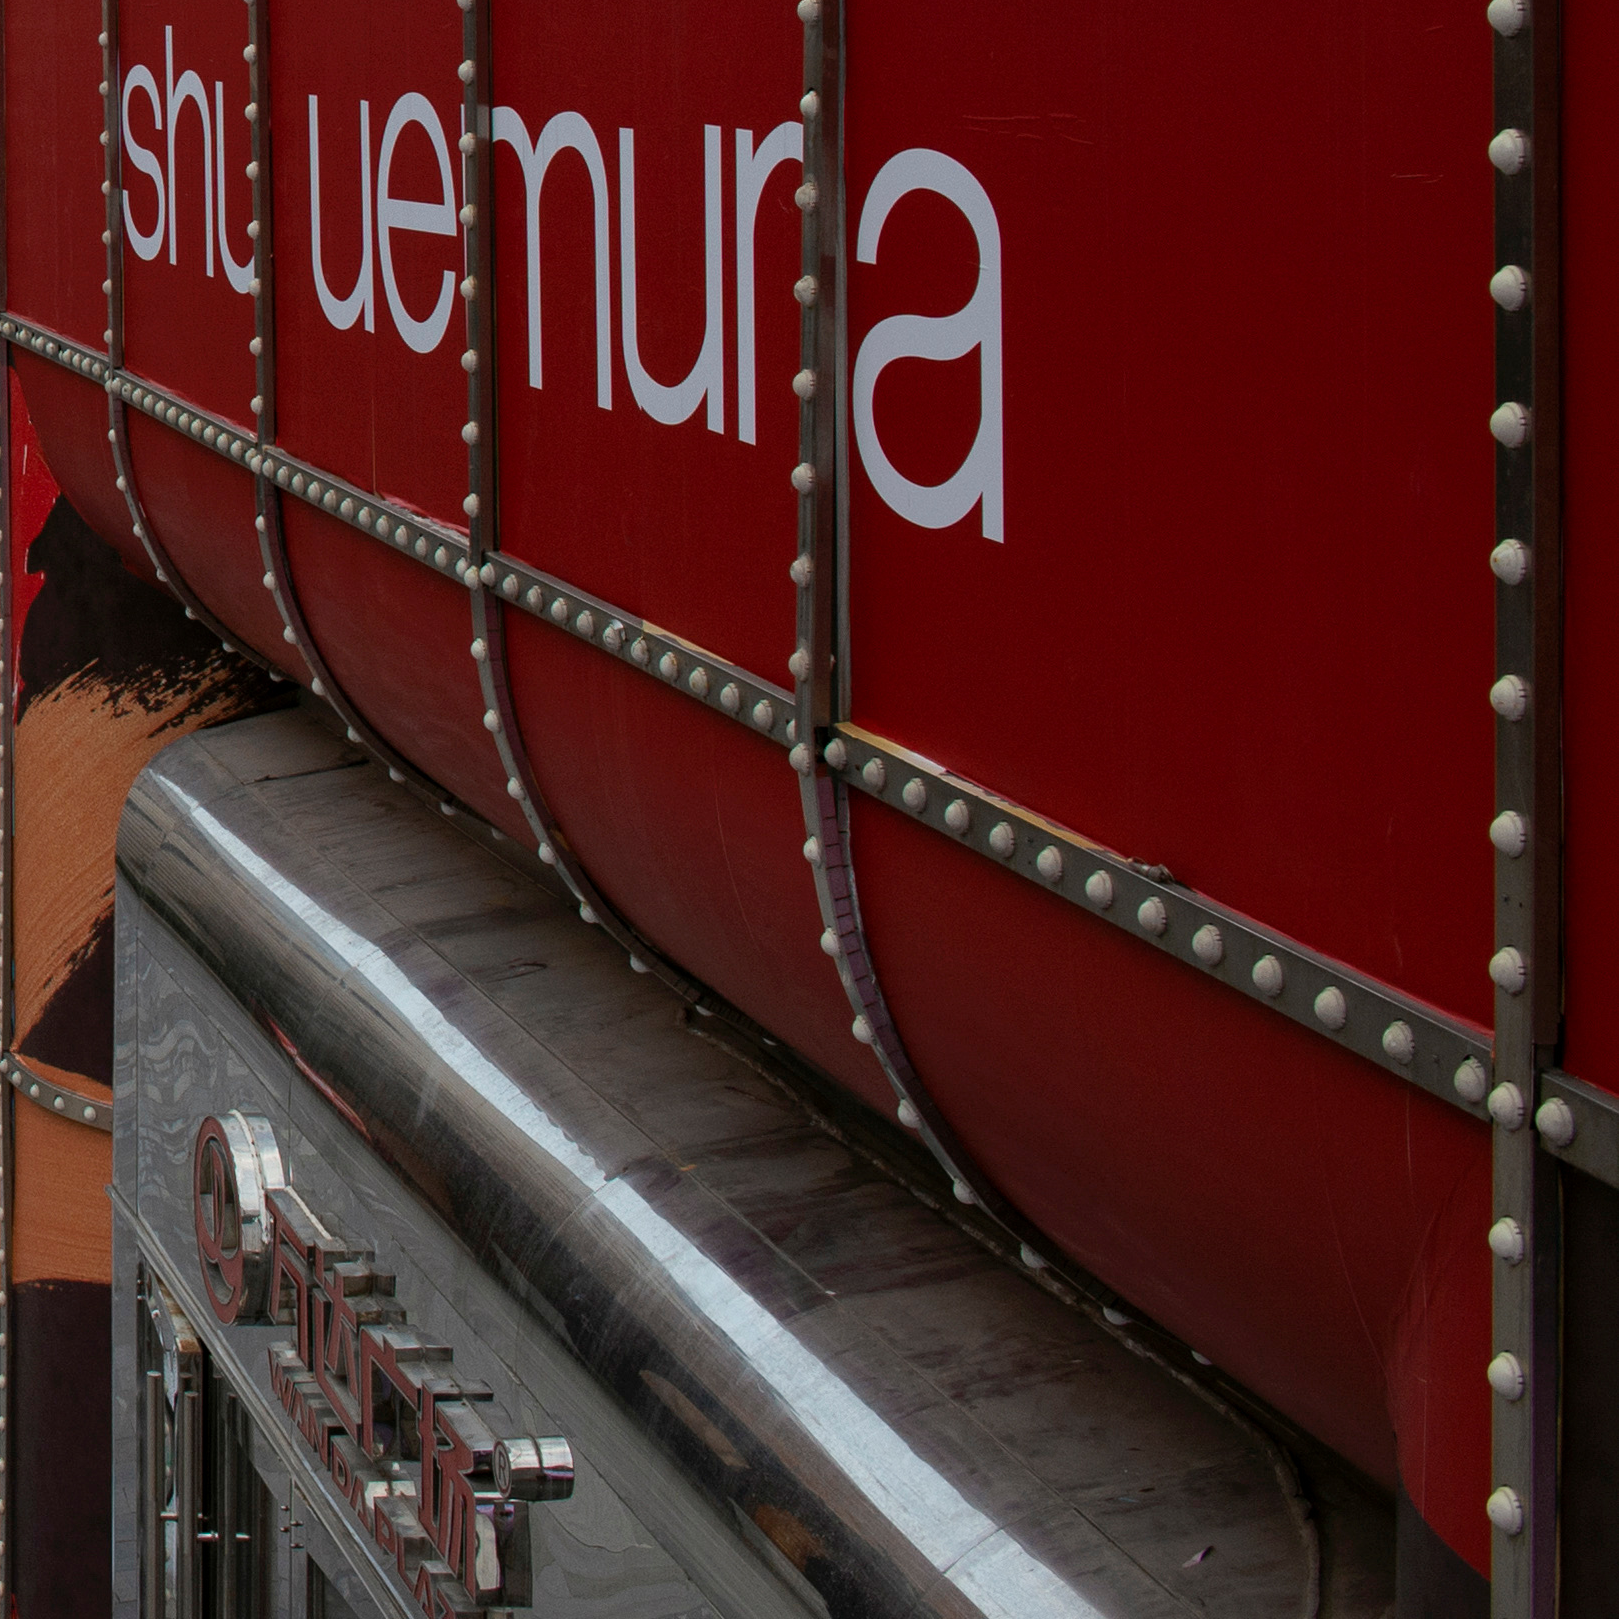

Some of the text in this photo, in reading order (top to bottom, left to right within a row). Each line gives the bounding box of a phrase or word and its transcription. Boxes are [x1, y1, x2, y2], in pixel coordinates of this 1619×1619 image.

[121, 25, 1005, 544] shu uemura
[268, 1343, 375, 1540] WANDA
